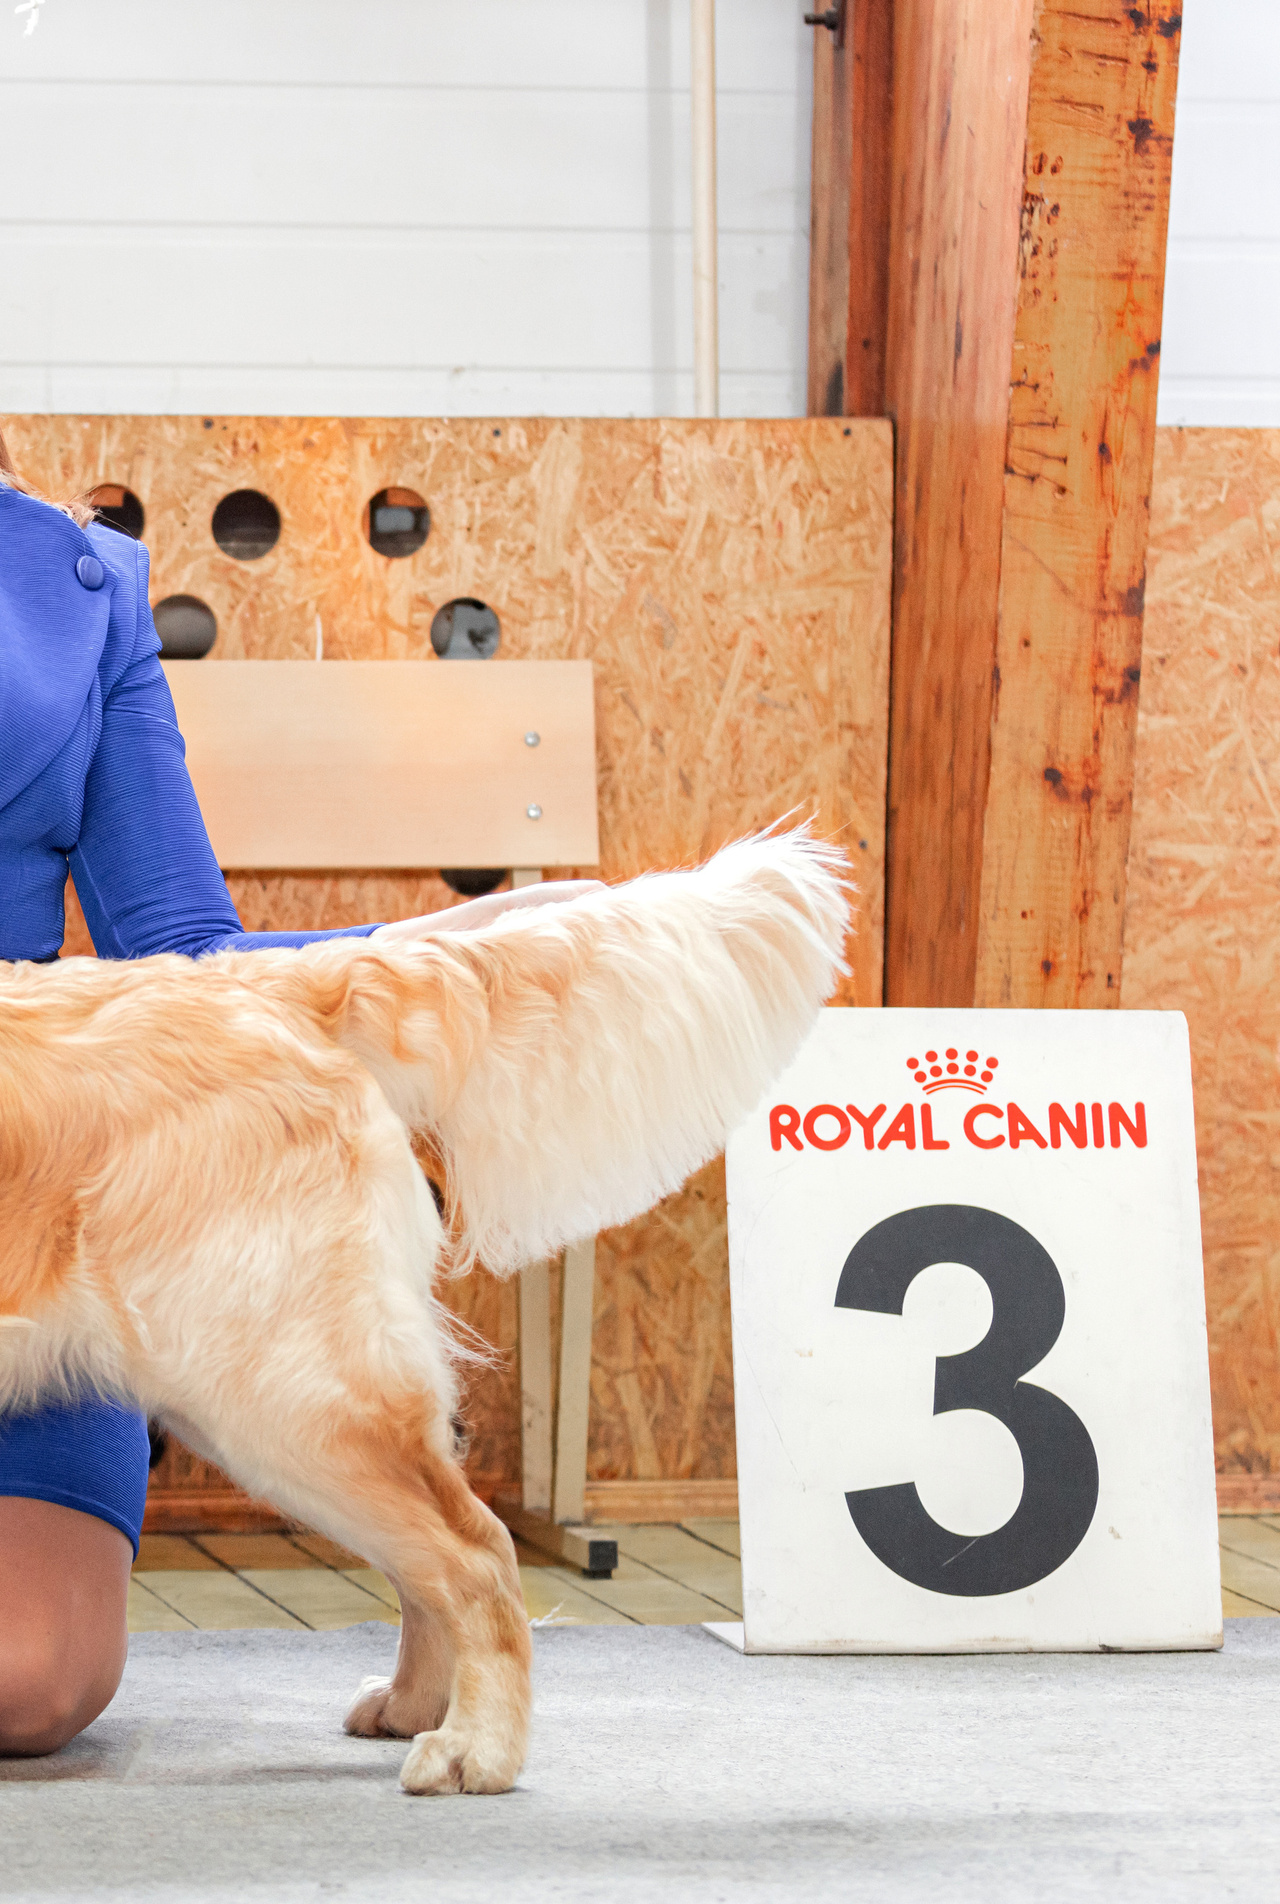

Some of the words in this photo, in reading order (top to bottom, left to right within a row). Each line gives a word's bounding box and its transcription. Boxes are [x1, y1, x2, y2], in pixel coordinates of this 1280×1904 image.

[769, 1103, 950, 1151] ROYAL
[963, 1101, 1148, 1150] CANIN
[834, 1204, 1099, 1597] 3
